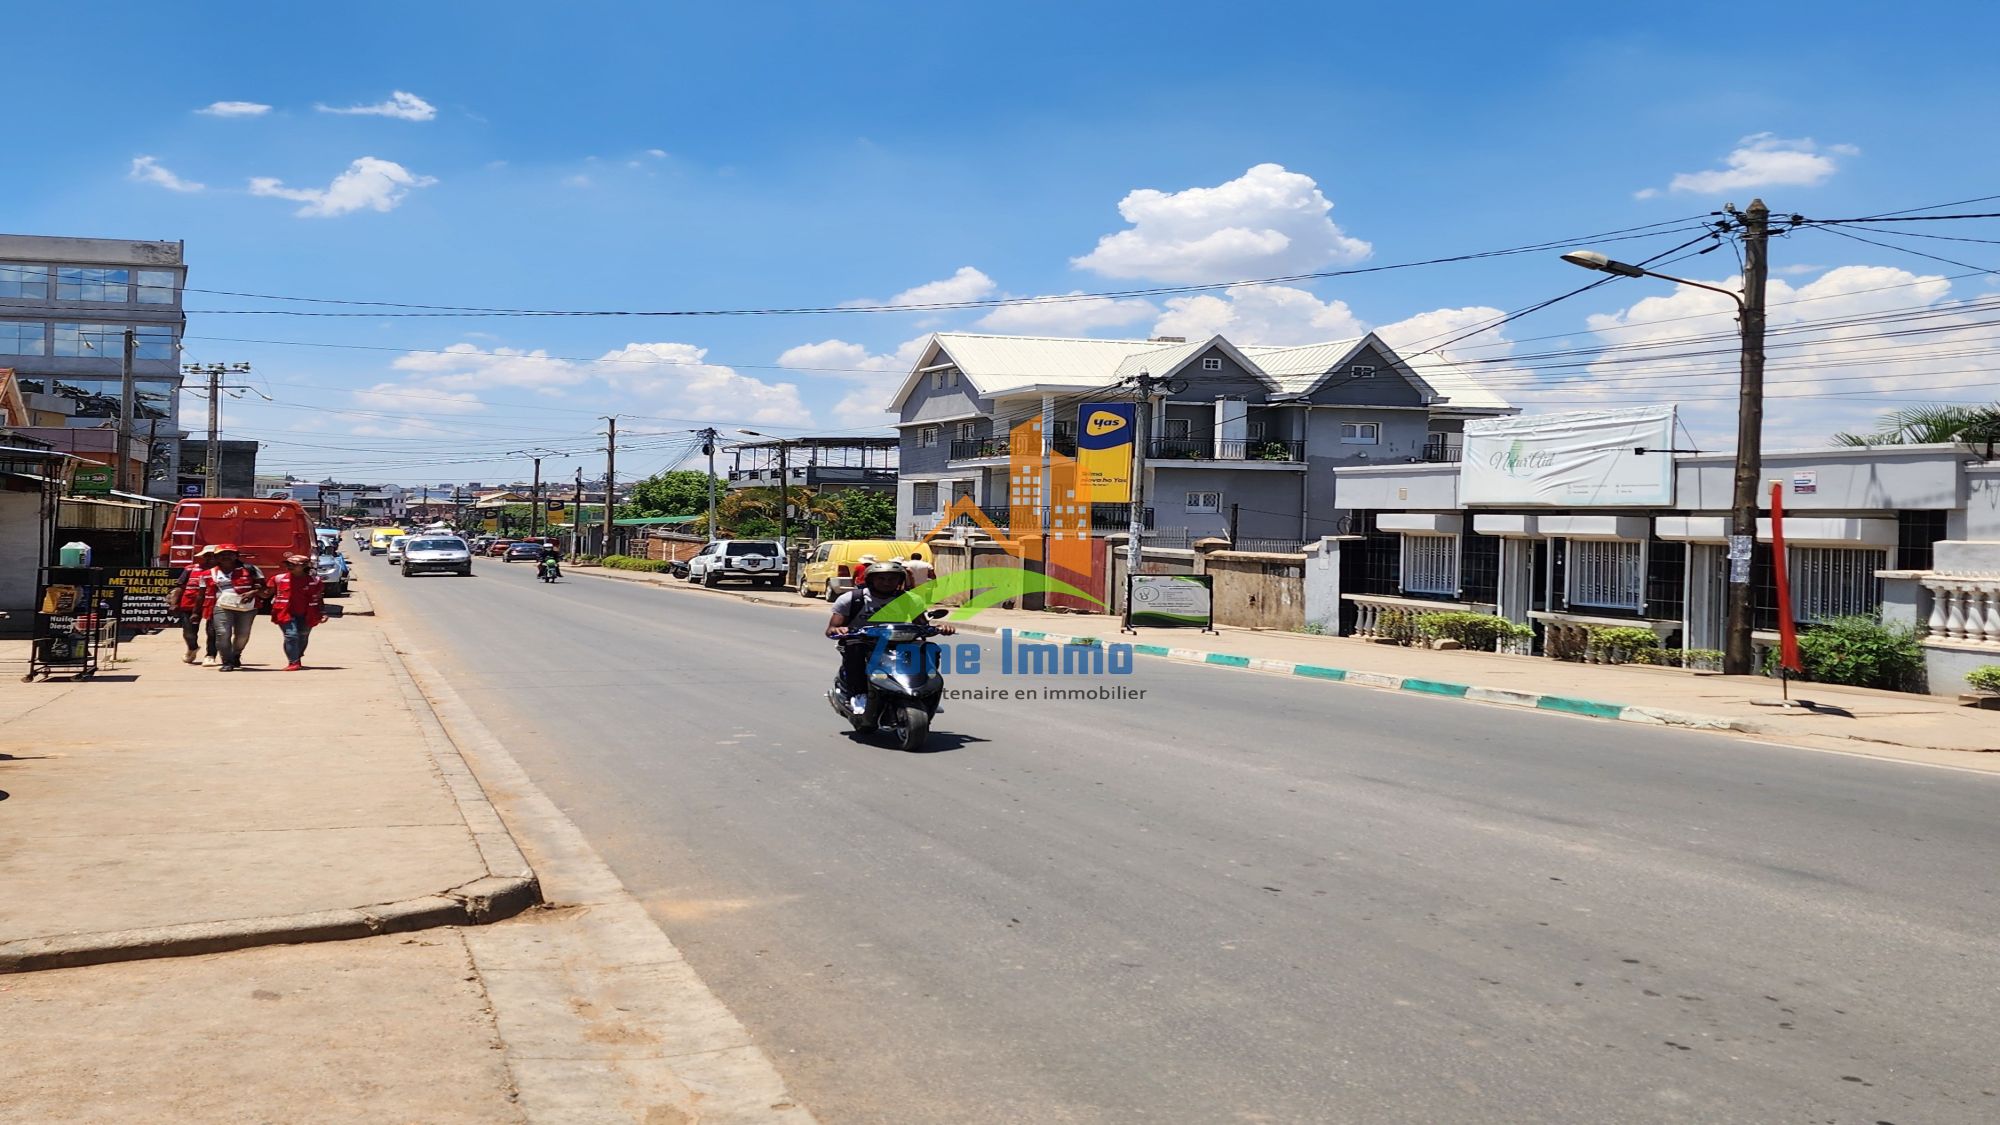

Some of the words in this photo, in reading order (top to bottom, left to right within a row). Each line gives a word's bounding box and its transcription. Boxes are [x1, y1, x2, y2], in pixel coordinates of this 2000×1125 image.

[119, 569, 169, 577] OUVRAGE
[108, 577, 178, 587] METALLIQUE
[167, 615, 180, 624] Vy
